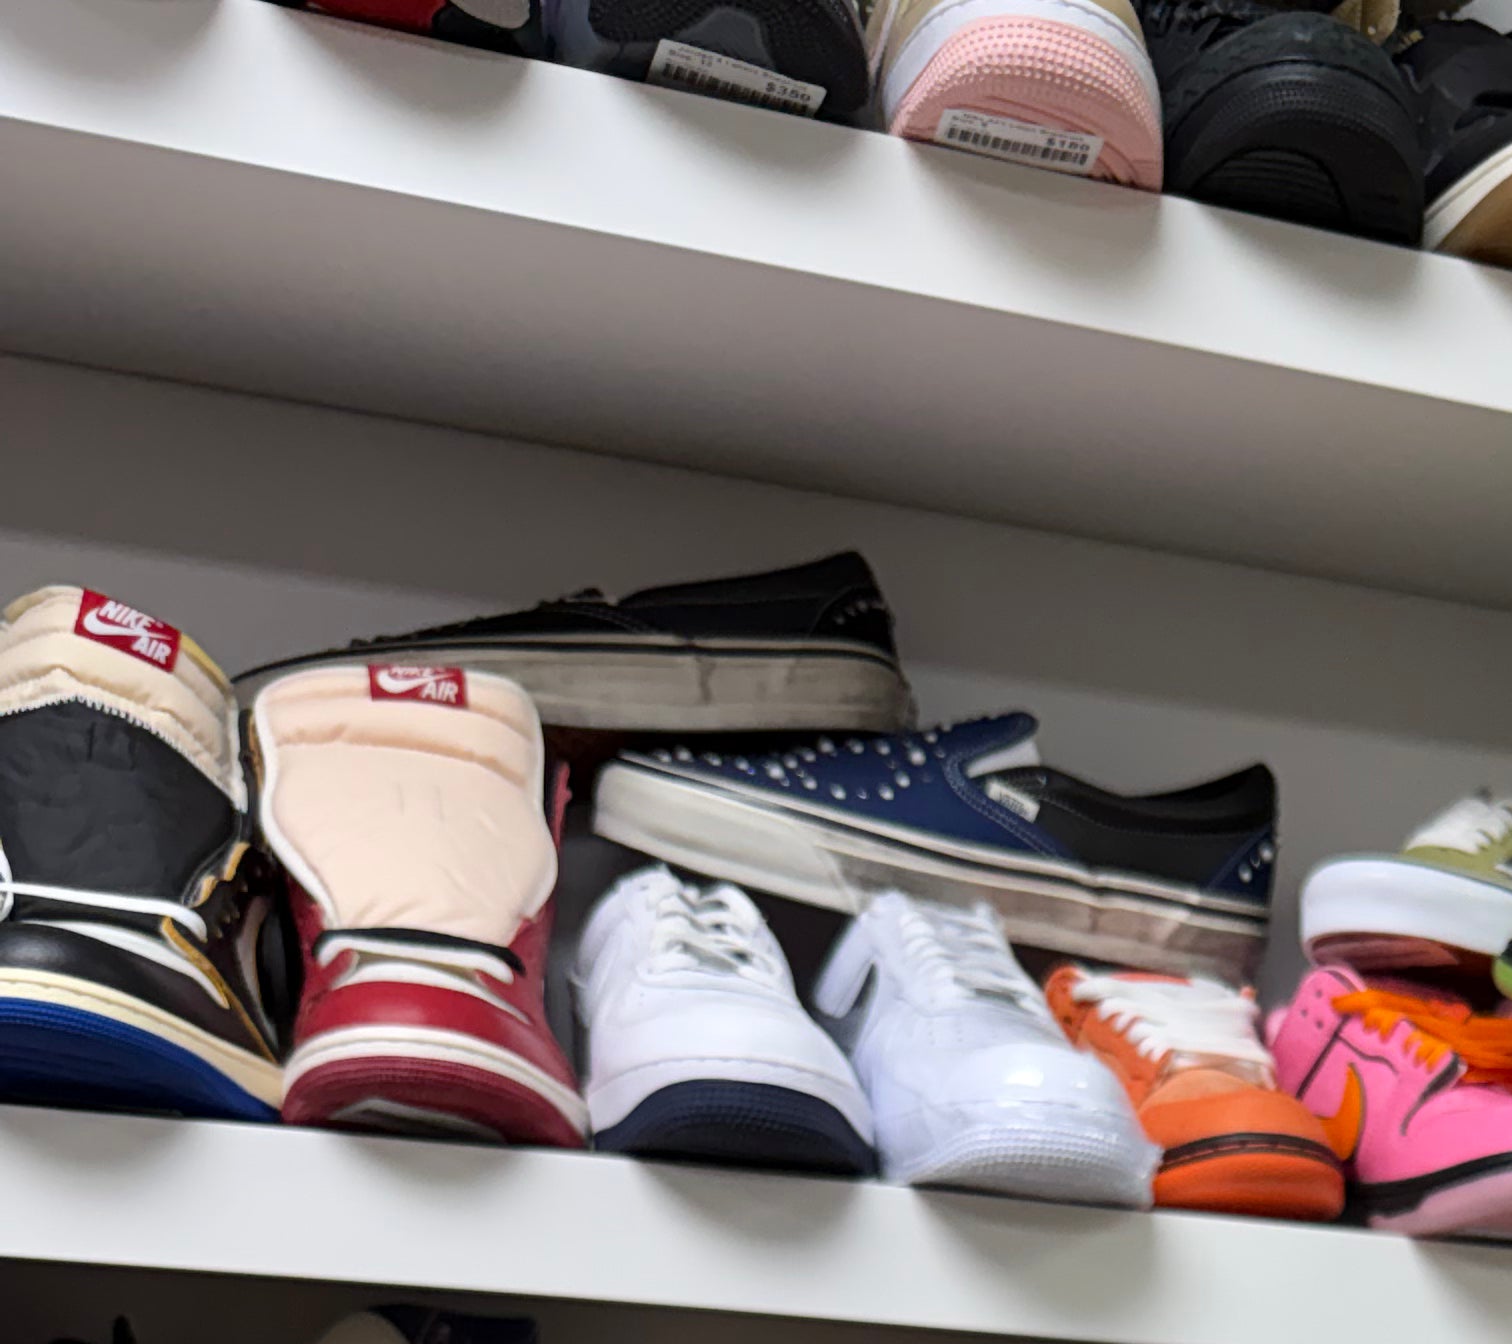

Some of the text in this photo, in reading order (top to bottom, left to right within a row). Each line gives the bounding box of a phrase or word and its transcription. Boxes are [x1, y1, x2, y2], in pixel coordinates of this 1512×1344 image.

[98, 600, 157, 630] NIKE
[131, 637, 172, 665] AIR
[421, 680, 460, 704] AIR
